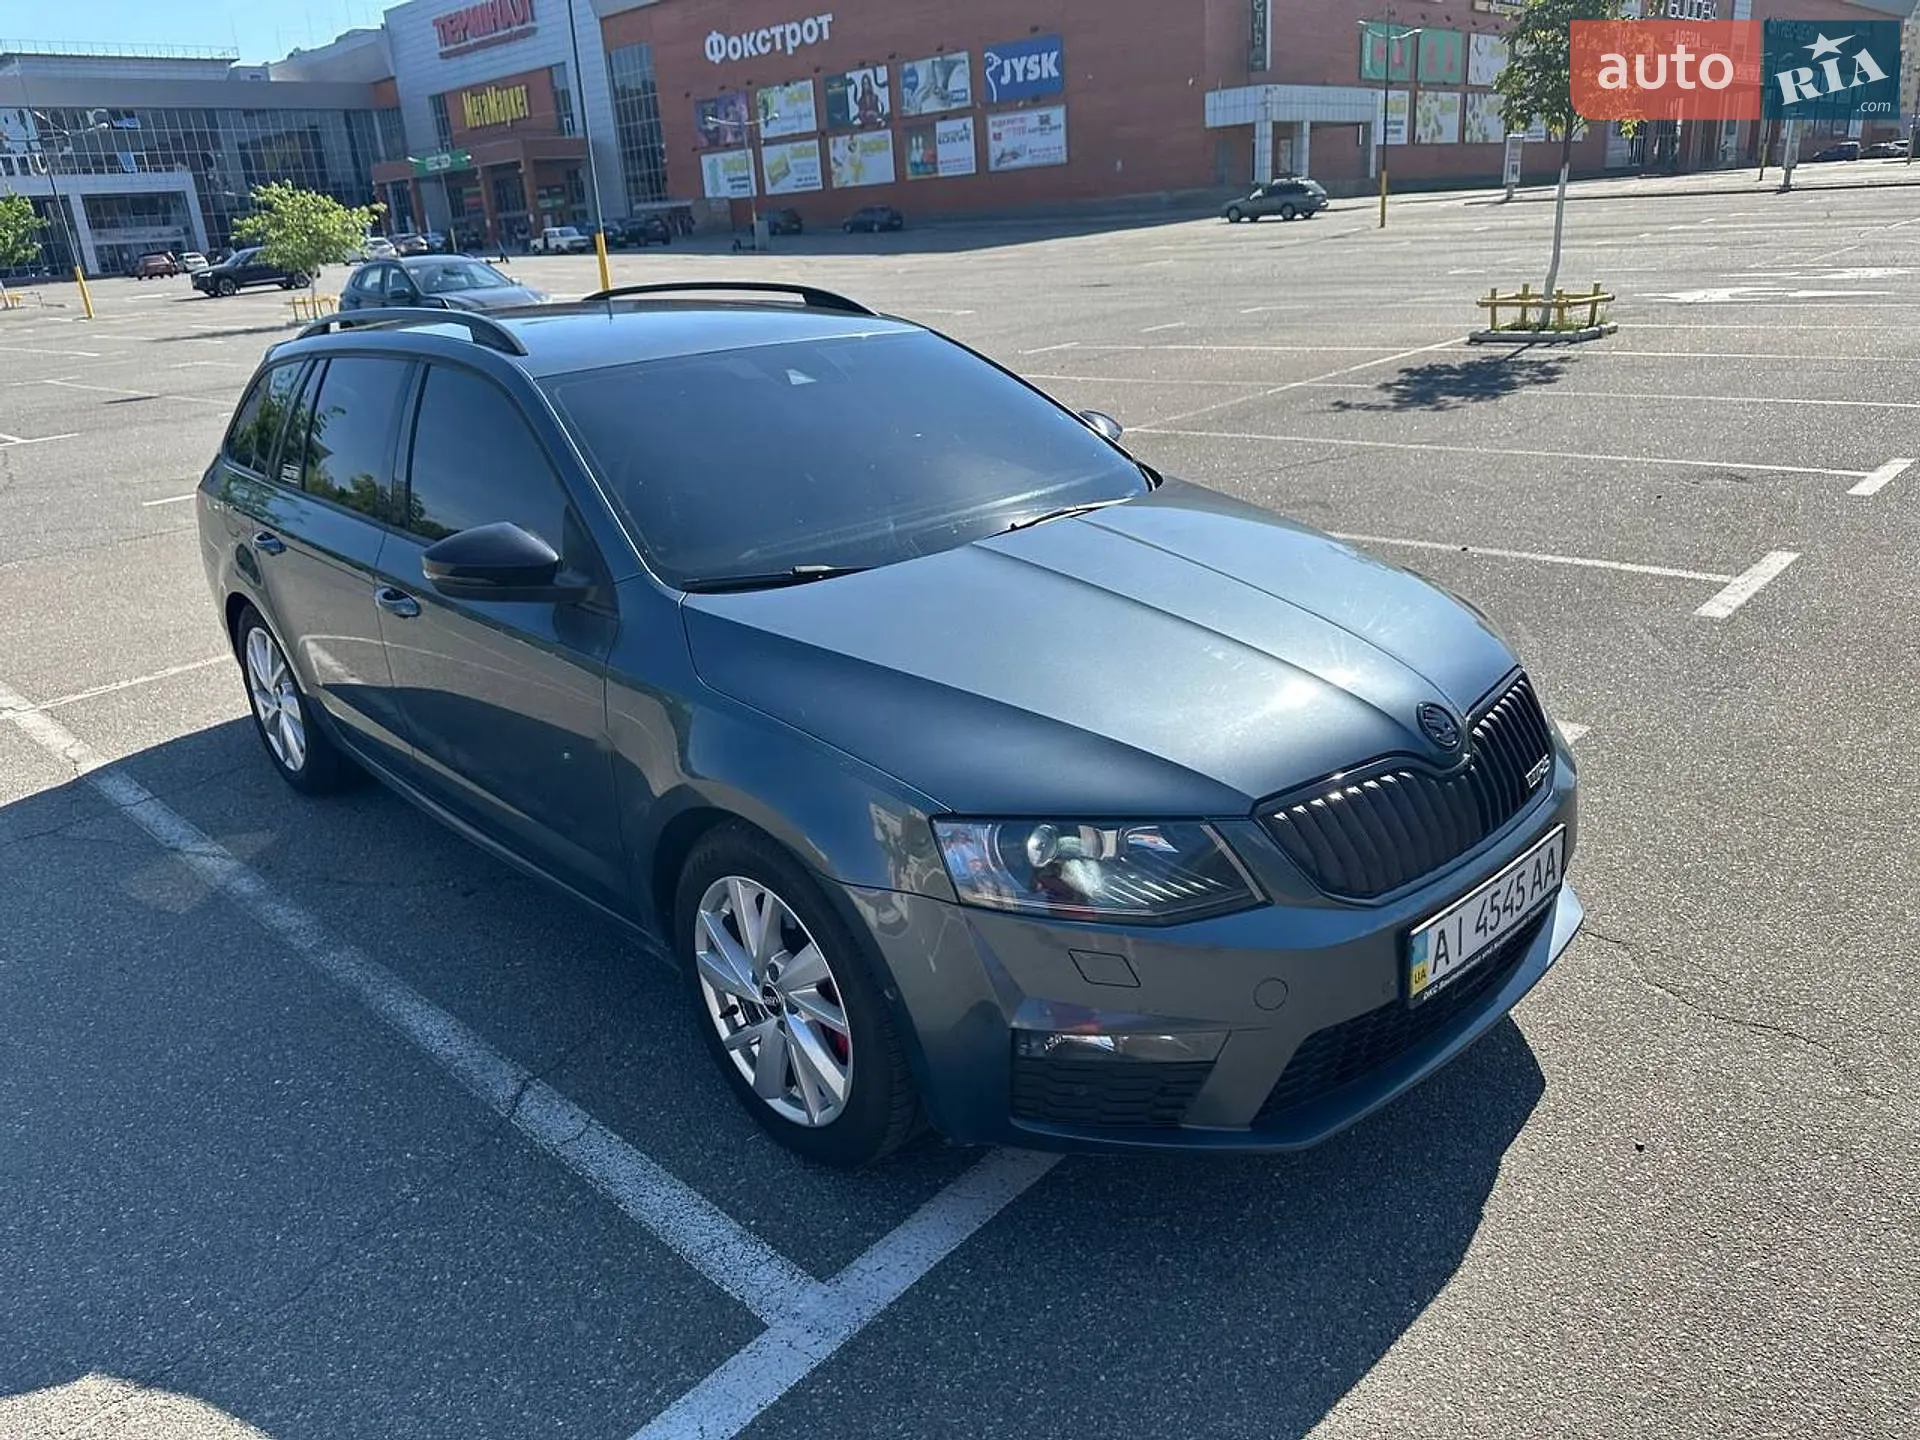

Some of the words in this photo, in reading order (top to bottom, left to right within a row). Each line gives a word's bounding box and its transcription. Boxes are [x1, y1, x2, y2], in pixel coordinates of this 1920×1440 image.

[704, 13, 833, 64] Фокстрот
[1001, 51, 1060, 85] JYSK
[462, 84, 530, 129] МегаМаркет
[1475, 871, 1526, 937] 4545
[1531, 847, 1556, 900] AA
[1414, 969, 1427, 985] UA
